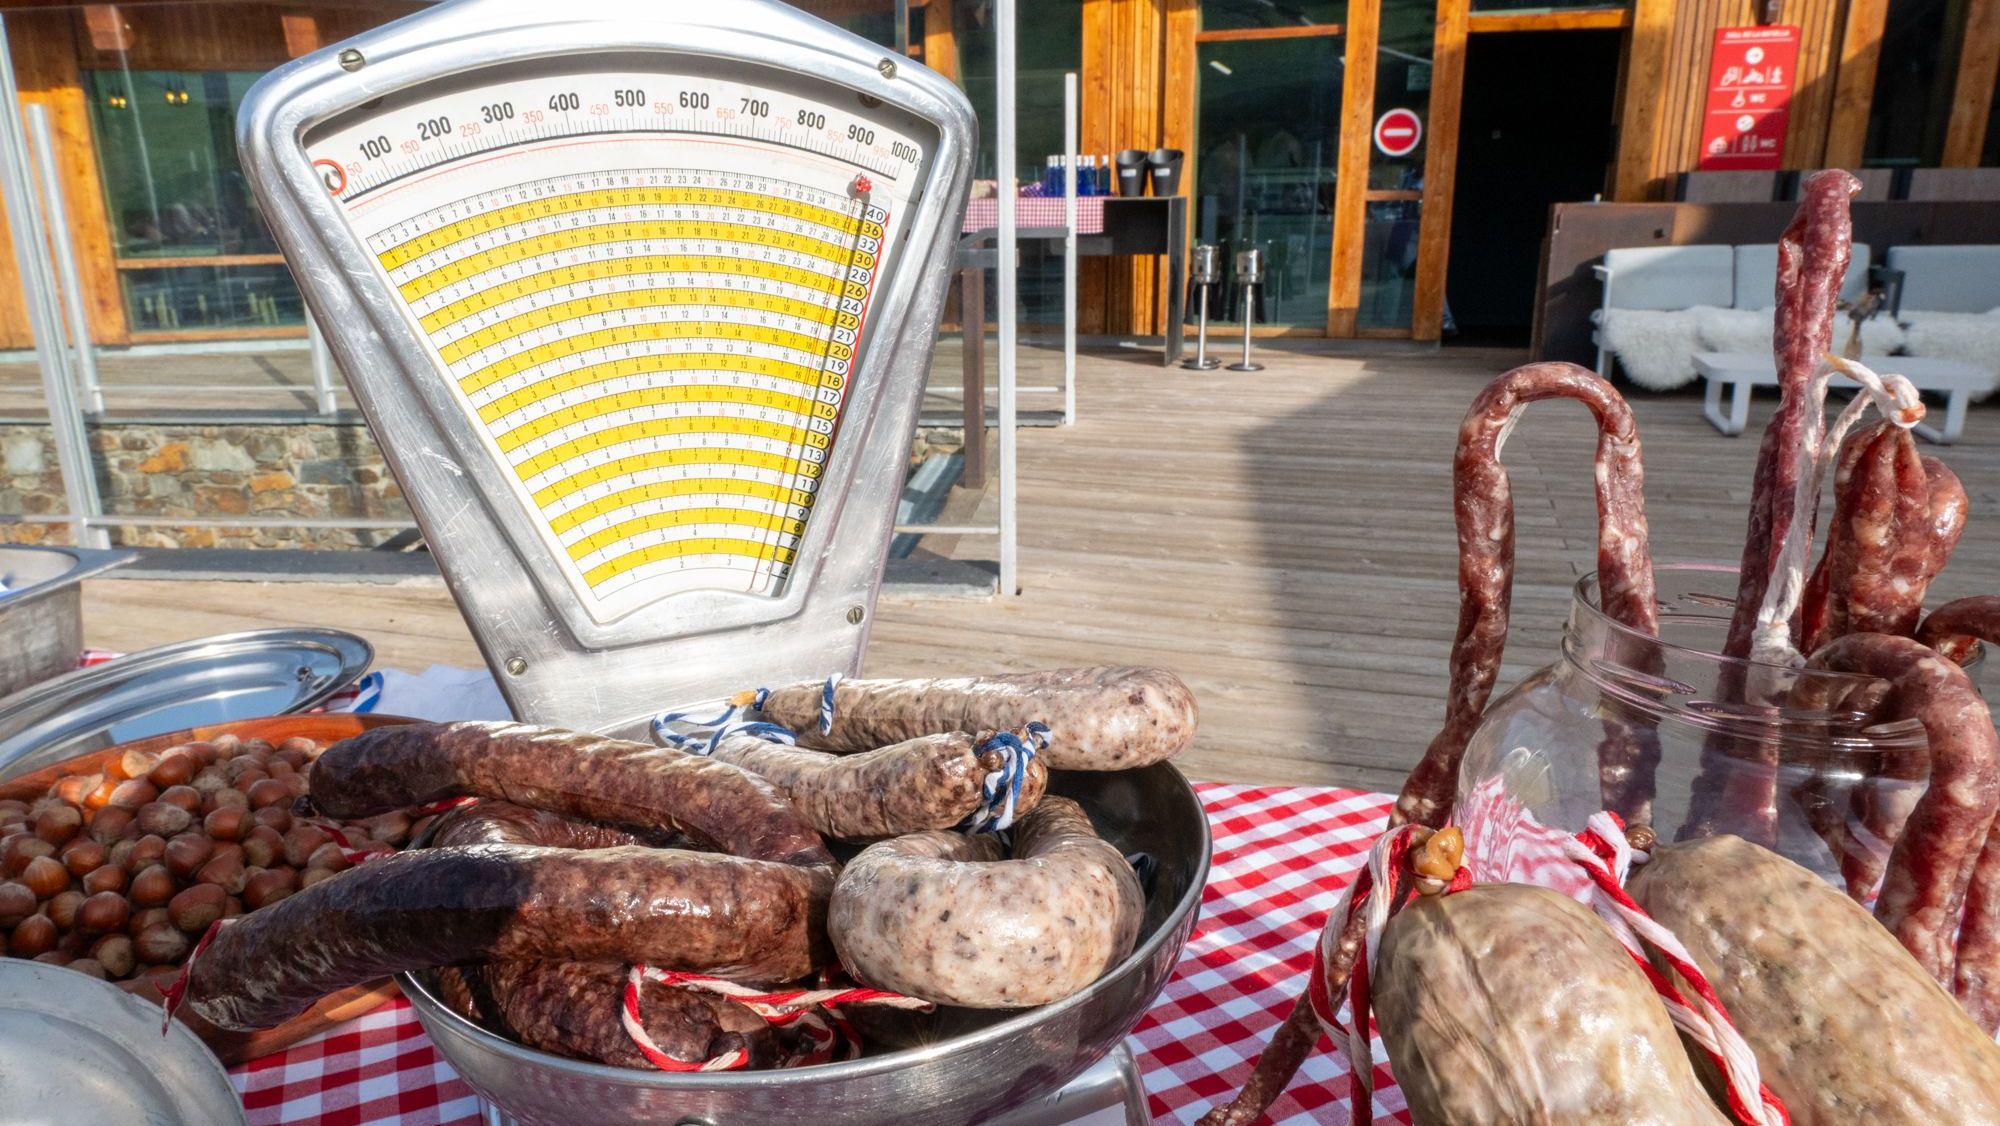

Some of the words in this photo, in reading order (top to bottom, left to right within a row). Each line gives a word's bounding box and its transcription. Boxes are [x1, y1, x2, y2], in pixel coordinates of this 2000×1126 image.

[346, 162, 363, 176] 50
[359, 136, 392, 160] 100
[400, 140, 420, 155] 150
[417, 116, 452, 141] 200
[459, 122, 481, 138] 250
[481, 102, 514, 124] 300
[523, 111, 544, 124] 350
[549, 93, 580, 112] 400
[590, 103, 609, 116] 450
[615, 90, 645, 107] 500
[654, 102, 673, 115] 550
[680, 92, 709, 109] 600
[717, 107, 735, 119] 650
[740, 98, 769, 118] 700
[774, 116, 791, 128] 750
[797, 110, 825, 130] 800
[847, 125, 875, 146] 900
[533, 187, 542, 196] 13
[546, 184, 556, 193] 14
[576, 180, 585, 189] 16
[606, 177, 614, 185] 18
[620, 176, 629, 184] 19
[693, 176, 700, 184] 24
[719, 177, 727, 186] 26
[745, 180, 753, 189] 28
[794, 190, 803, 199] 32
[817, 195, 826, 205] 34
[867, 208, 883, 221] 40
[573, 198, 583, 207] 14
[637, 193, 646, 201] 18
[864, 223, 879, 235] 36
[673, 210, 681, 218] 18
[860, 238, 875, 251] 32
[623, 228, 632, 236] 14
[855, 253, 871, 266] 30
[714, 245, 722, 253] 18
[852, 269, 867, 281] 28
[686, 277, 694, 285] 14
[843, 299, 858, 312] 24
[848, 284, 863, 296] 26
[840, 314, 855, 326] 22
[836, 330, 851, 341] 21
[833, 345, 848, 358] 20
[830, 360, 845, 372] 19
[827, 375, 841, 386] 18
[823, 391, 836, 402] 17
[819, 406, 832, 417] 16
[816, 421, 829, 432] 15
[812, 436, 825, 447] 14
[809, 449, 821, 461] 13
[805, 464, 818, 476] 12
[802, 480, 814, 490] 11
[798, 494, 811, 504] 10
[798, 509, 804, 519] 9
[794, 523, 801, 533] 8
[791, 538, 798, 546] 7
[786, 552, 793, 561] 6
[782, 567, 789, 576] 4
